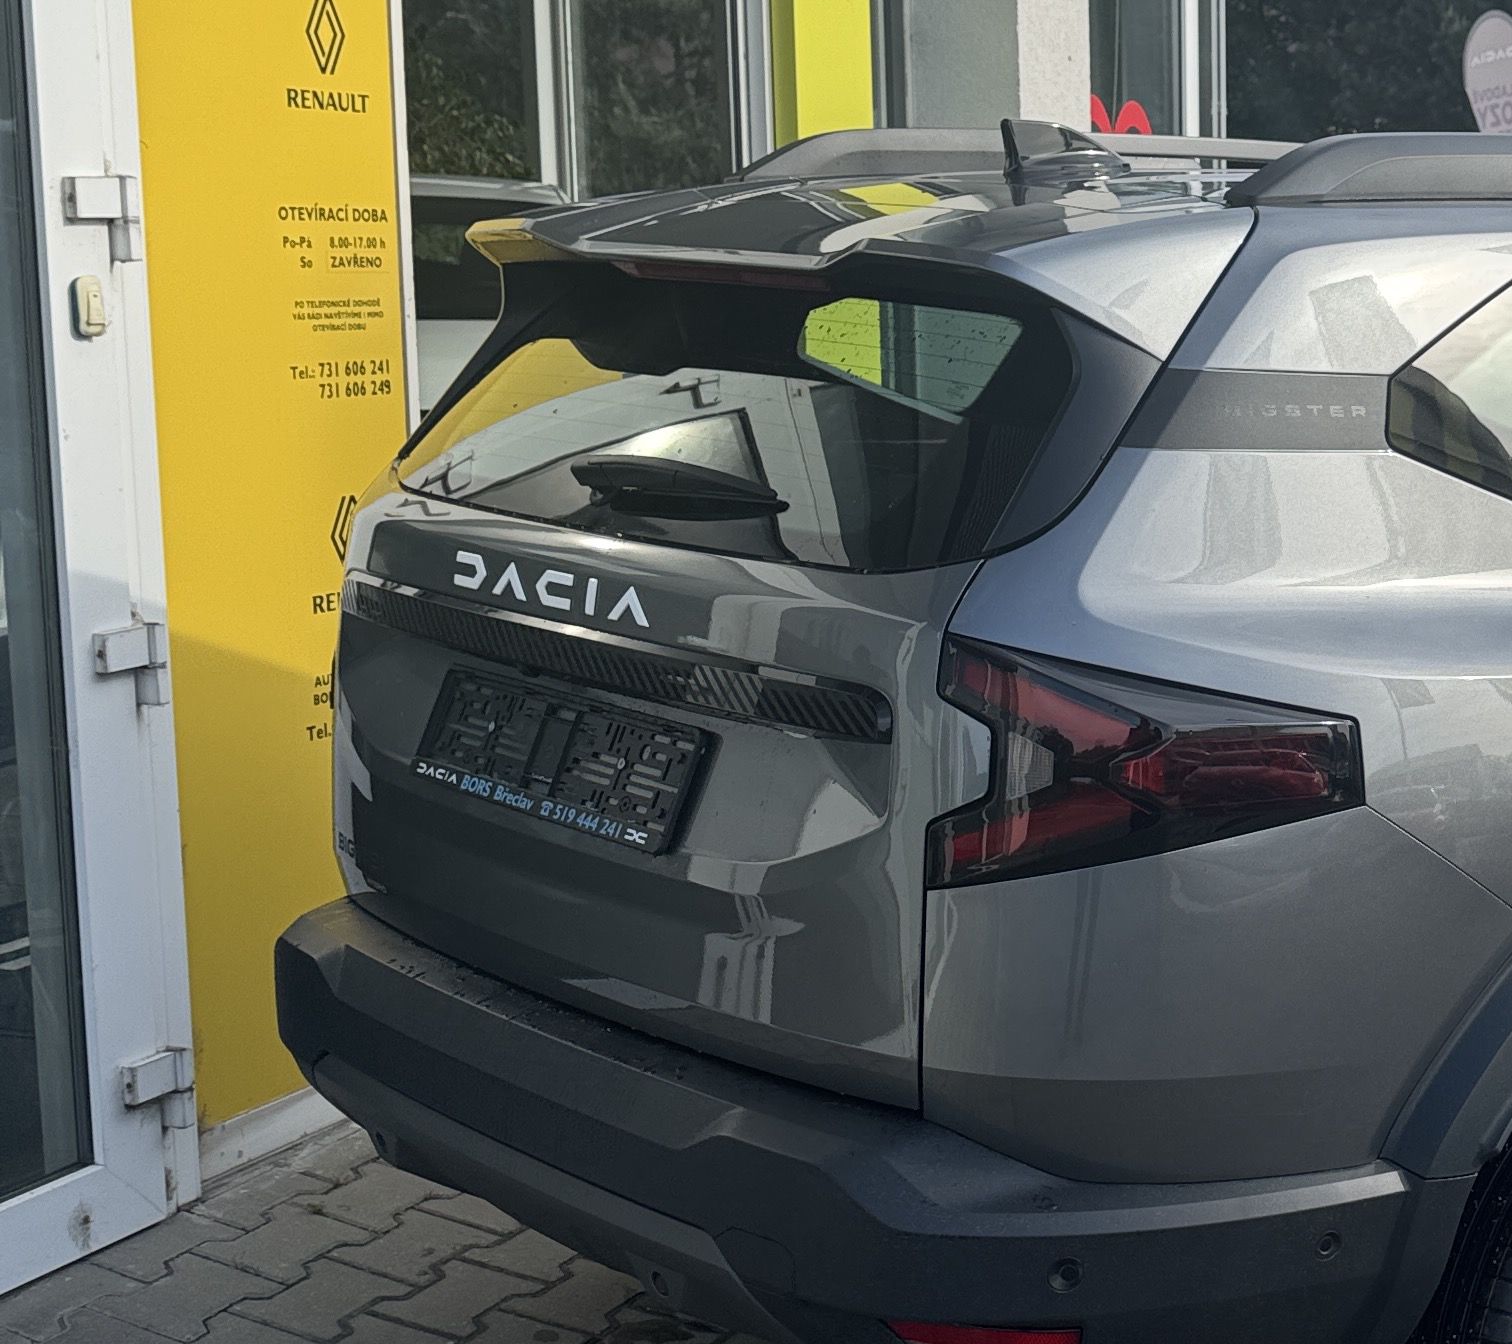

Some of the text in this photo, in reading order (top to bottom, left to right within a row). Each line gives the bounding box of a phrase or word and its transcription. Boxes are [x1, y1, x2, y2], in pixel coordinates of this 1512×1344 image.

[286, 87, 369, 113] RENAULT
[277, 202, 388, 223] OTEVÍRACÍ DOBA
[282, 235, 313, 249] Po-Pá
[300, 253, 383, 269] So ZAVŘENO
[318, 361, 340, 378] 731
[344, 360, 367, 377] 606
[370, 358, 390, 375] 241
[319, 379, 391, 399] 731 606 249
[453, 550, 650, 628] DACIA
[416, 762, 623, 839] DACIA BORS Břeclav 519 444 241
